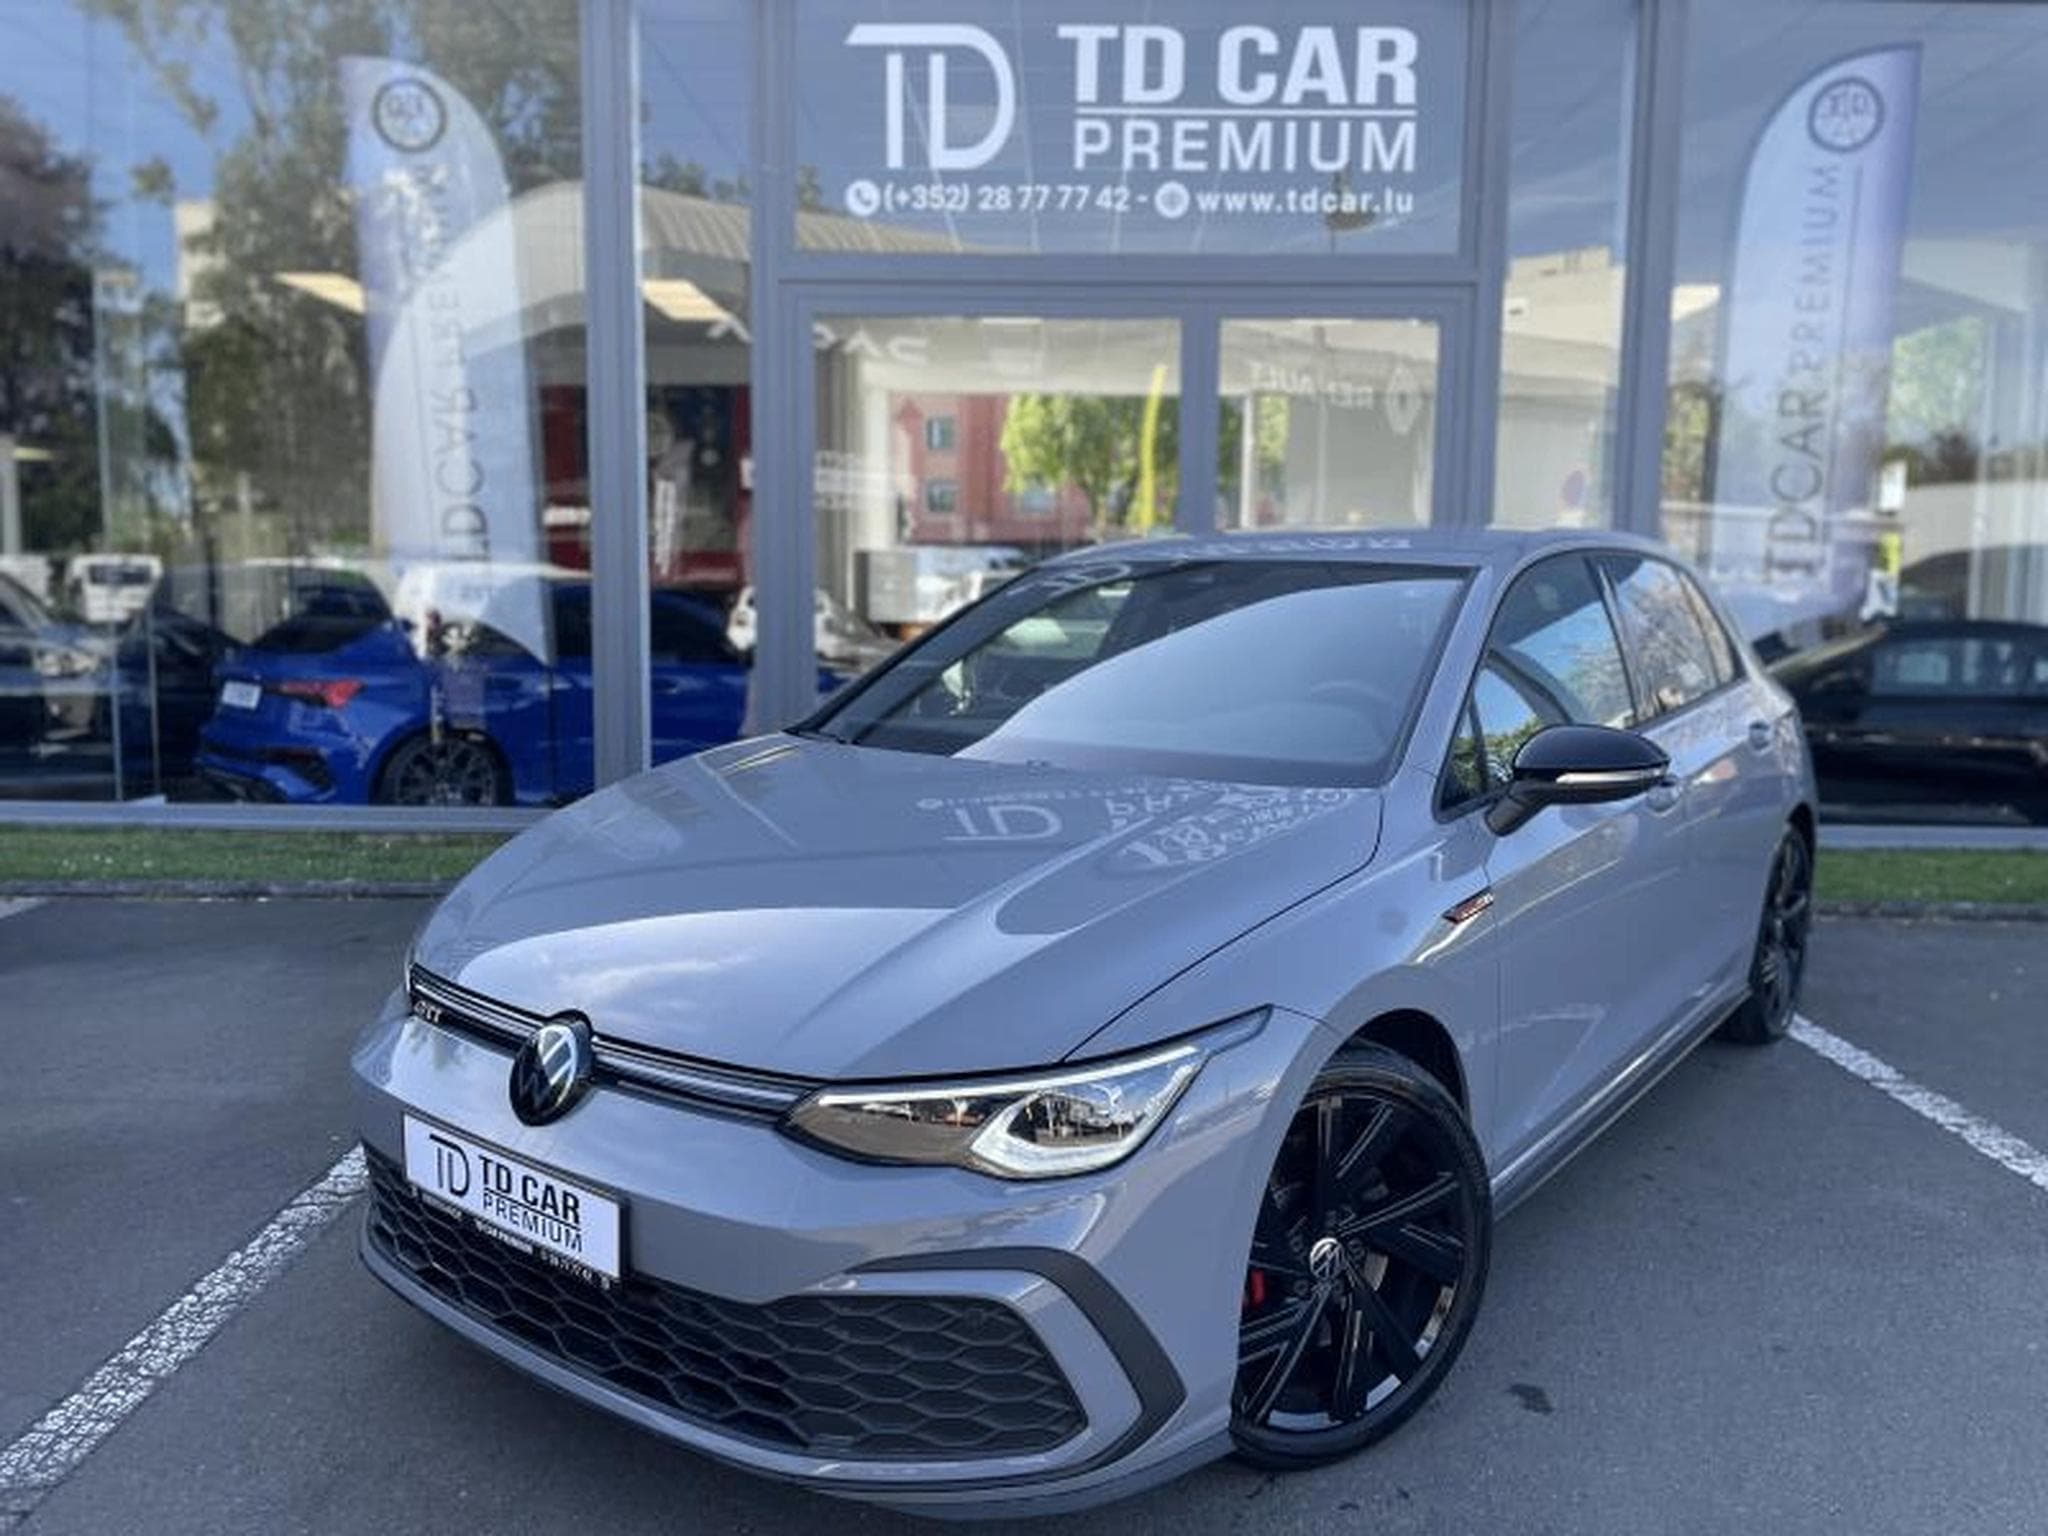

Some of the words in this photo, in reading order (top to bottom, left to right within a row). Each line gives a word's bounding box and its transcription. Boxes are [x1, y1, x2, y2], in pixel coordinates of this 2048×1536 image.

[1057, 25, 1184, 104] TD
[1217, 25, 1419, 105] CAR
[1073, 119, 1417, 171] PREMIUM
[884, 181, 970, 213] (+352)
[977, 184, 1012, 211] 28
[1017, 184, 1050, 211] 77
[1056, 184, 1090, 211] 77
[1096, 184, 1131, 213] 42
[1196, 186, 1415, 213] www.tdcar.lu
[1785, 164, 1841, 377] PREMIUM
[478, 1154, 513, 1194] TD
[521, 1174, 580, 1225] CAR
[482, 1192, 582, 1252] PREMIUM
